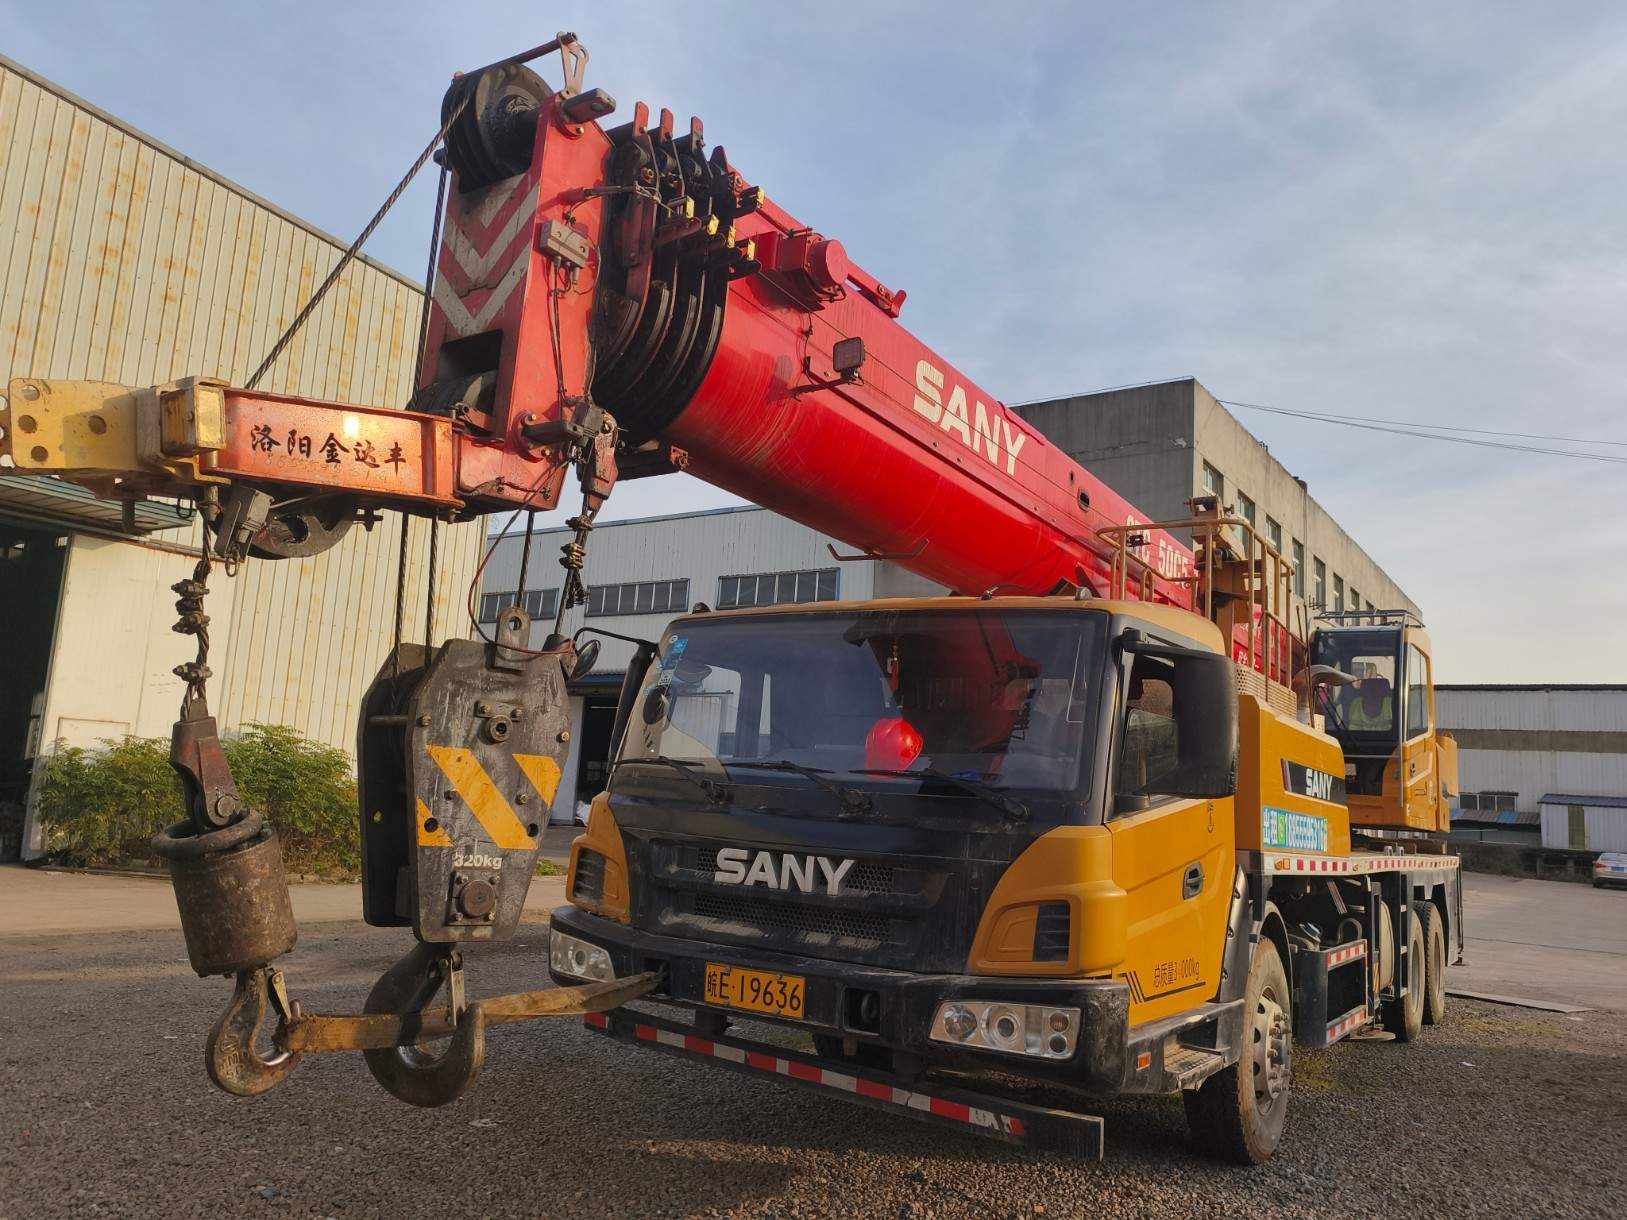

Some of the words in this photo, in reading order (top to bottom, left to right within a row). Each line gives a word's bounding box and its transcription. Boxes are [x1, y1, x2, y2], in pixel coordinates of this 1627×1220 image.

[913, 360, 1026, 476] SANY
[1305, 768, 1333, 801] SANY
[454, 853, 503, 870] 320kg
[714, 847, 855, 896] SANY
[1153, 958, 1200, 988] 总质量3000kg
